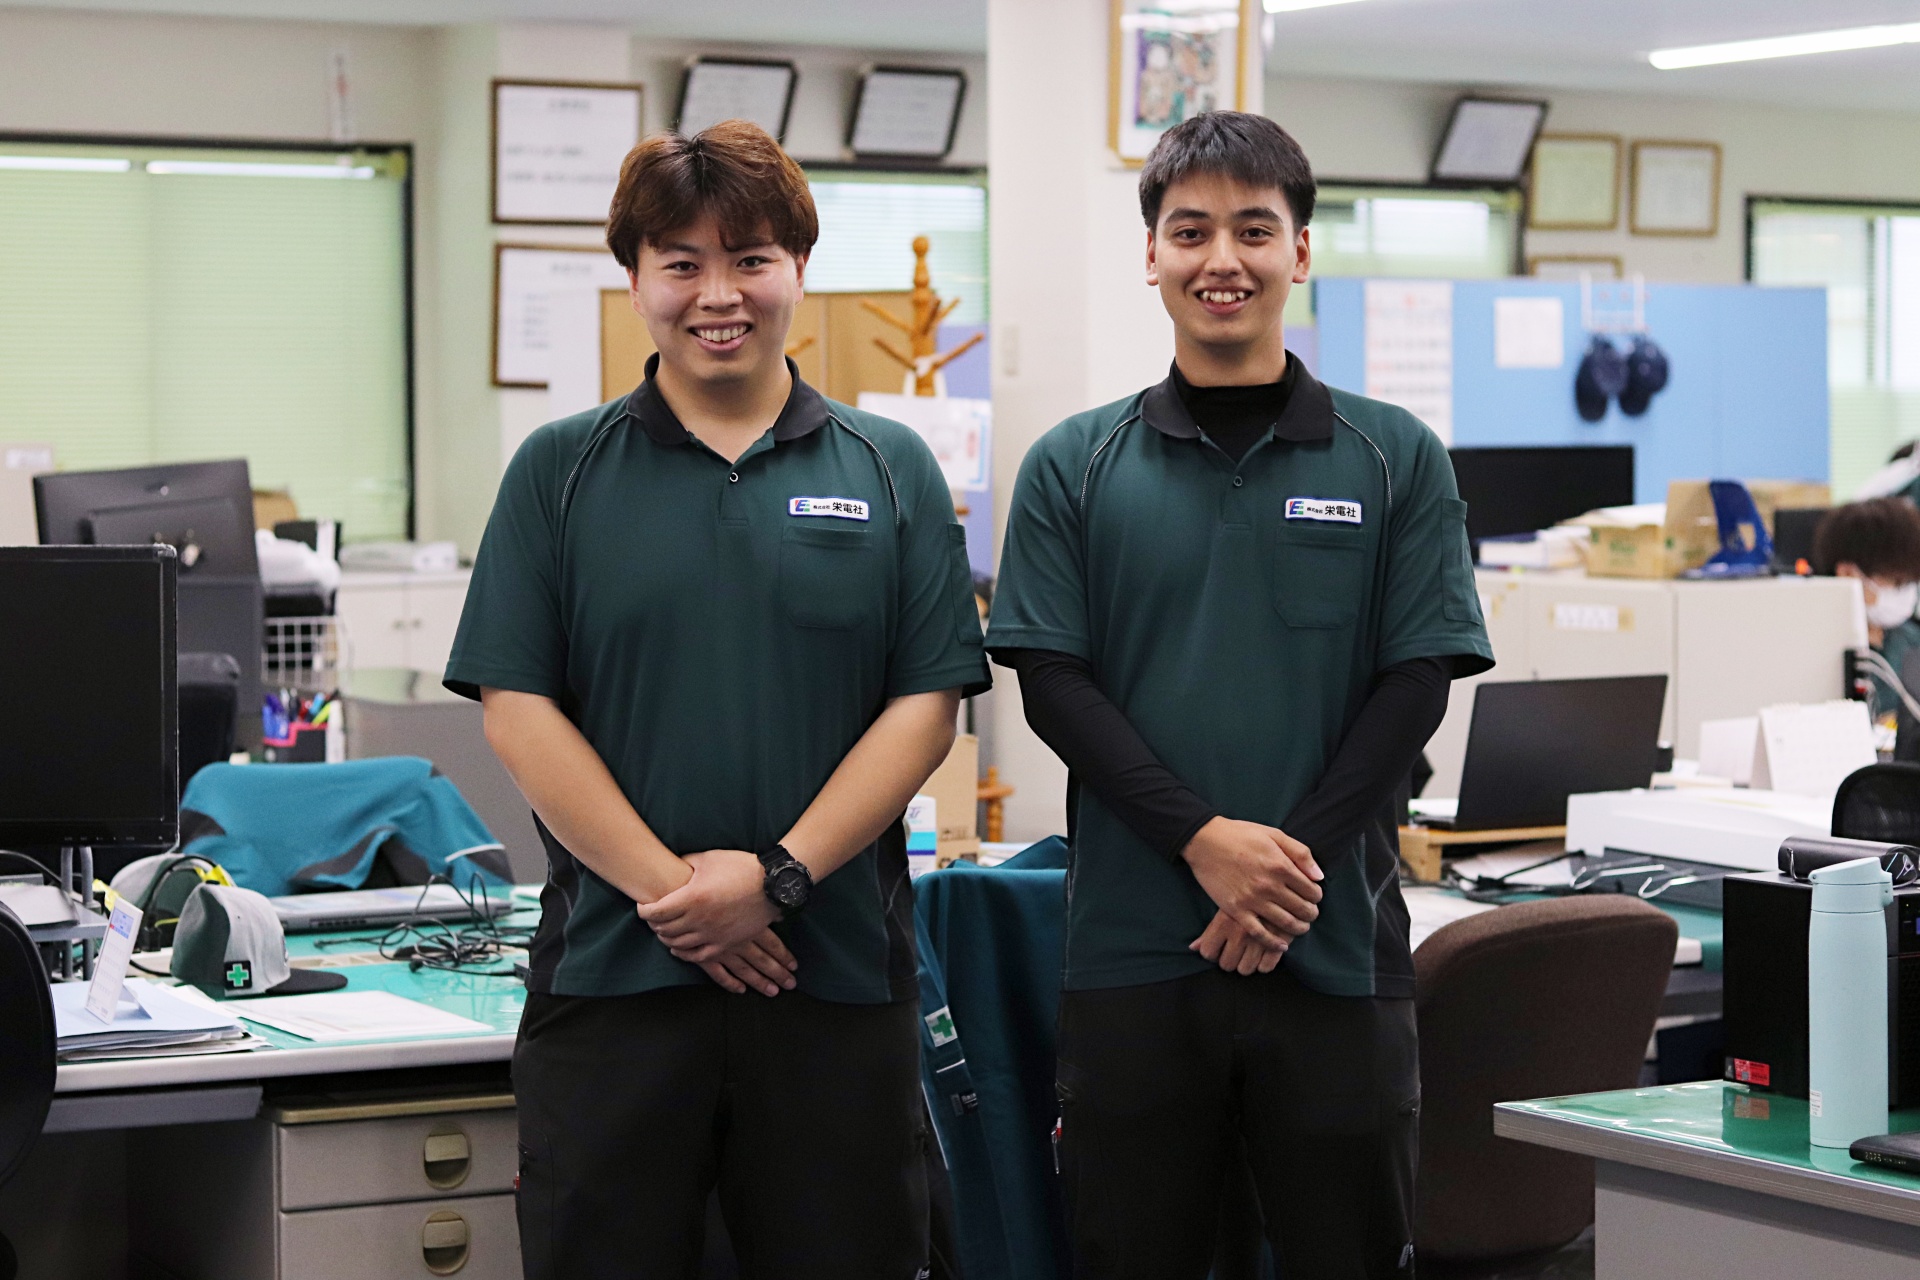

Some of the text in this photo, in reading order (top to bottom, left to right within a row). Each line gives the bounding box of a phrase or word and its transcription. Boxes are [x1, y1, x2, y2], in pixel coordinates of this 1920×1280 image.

[832, 502, 863, 515] 栄電社
[1325, 505, 1356, 517] 栄電社
